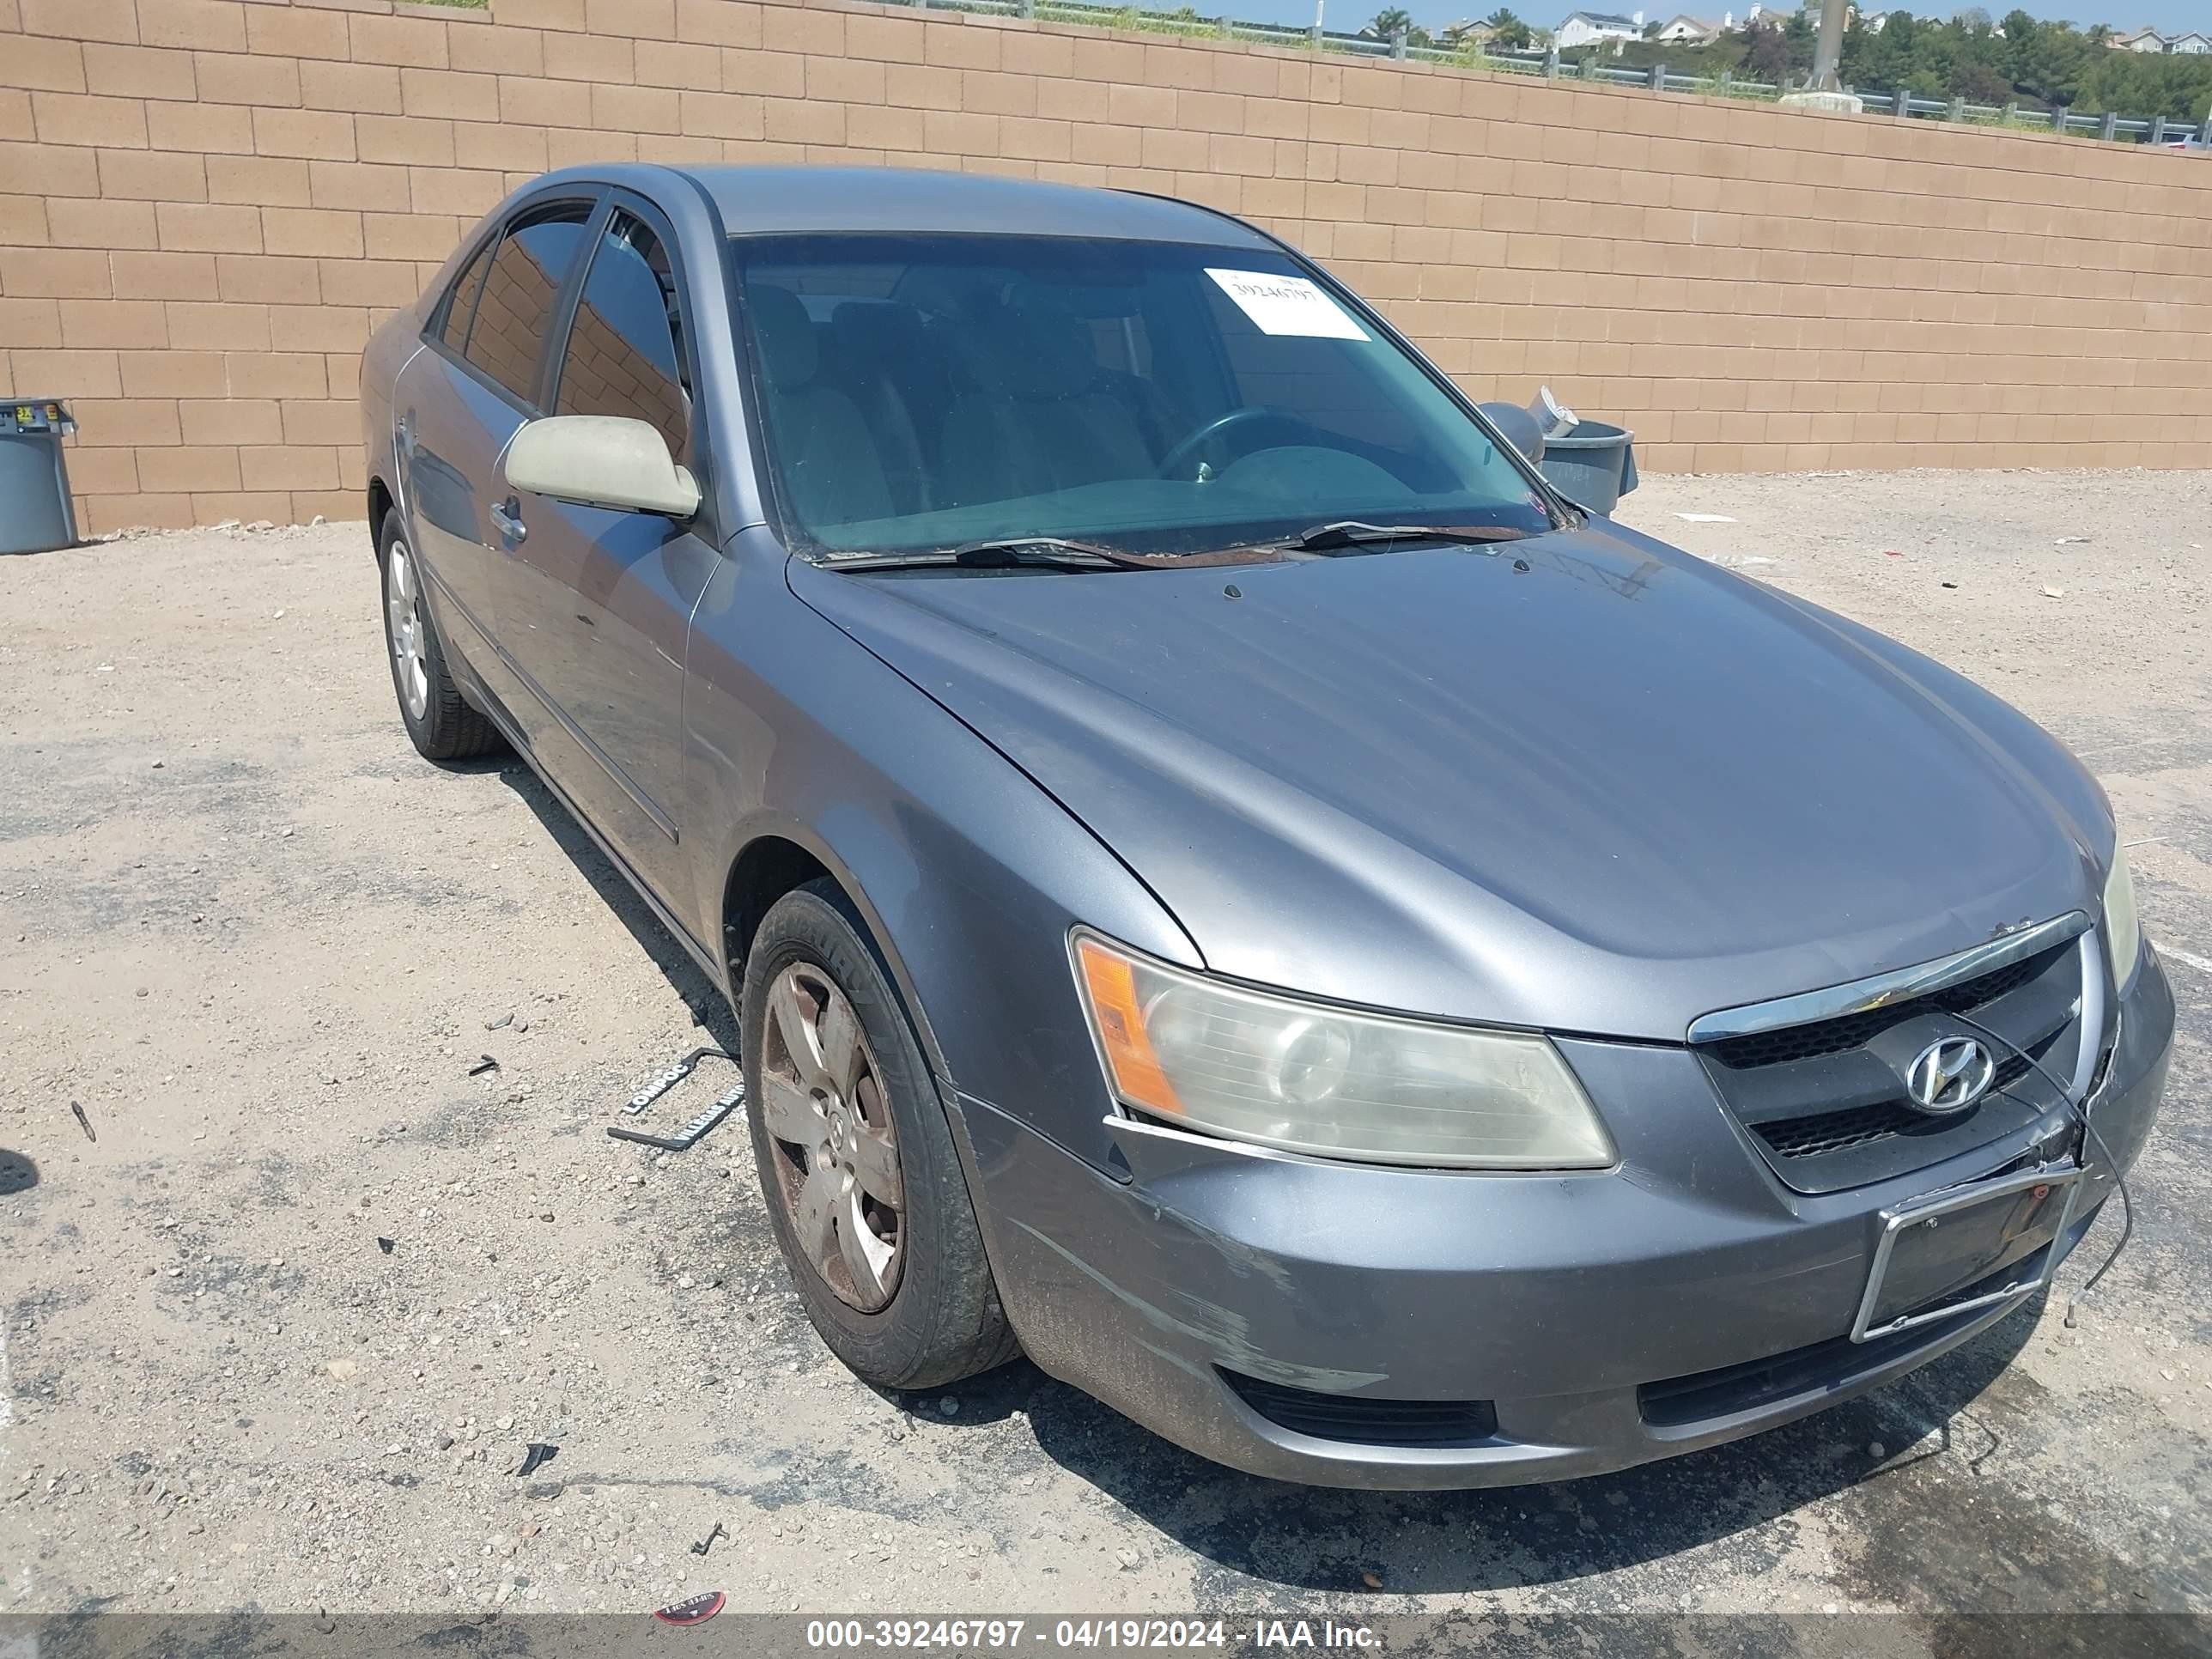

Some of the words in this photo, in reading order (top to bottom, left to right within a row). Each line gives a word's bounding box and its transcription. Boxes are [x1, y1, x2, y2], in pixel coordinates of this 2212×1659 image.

[623, 1064, 689, 1114] LOMPOC
[673, 1104, 726, 1141] VILLEGAS
[719, 1084, 745, 1106] AUTO
